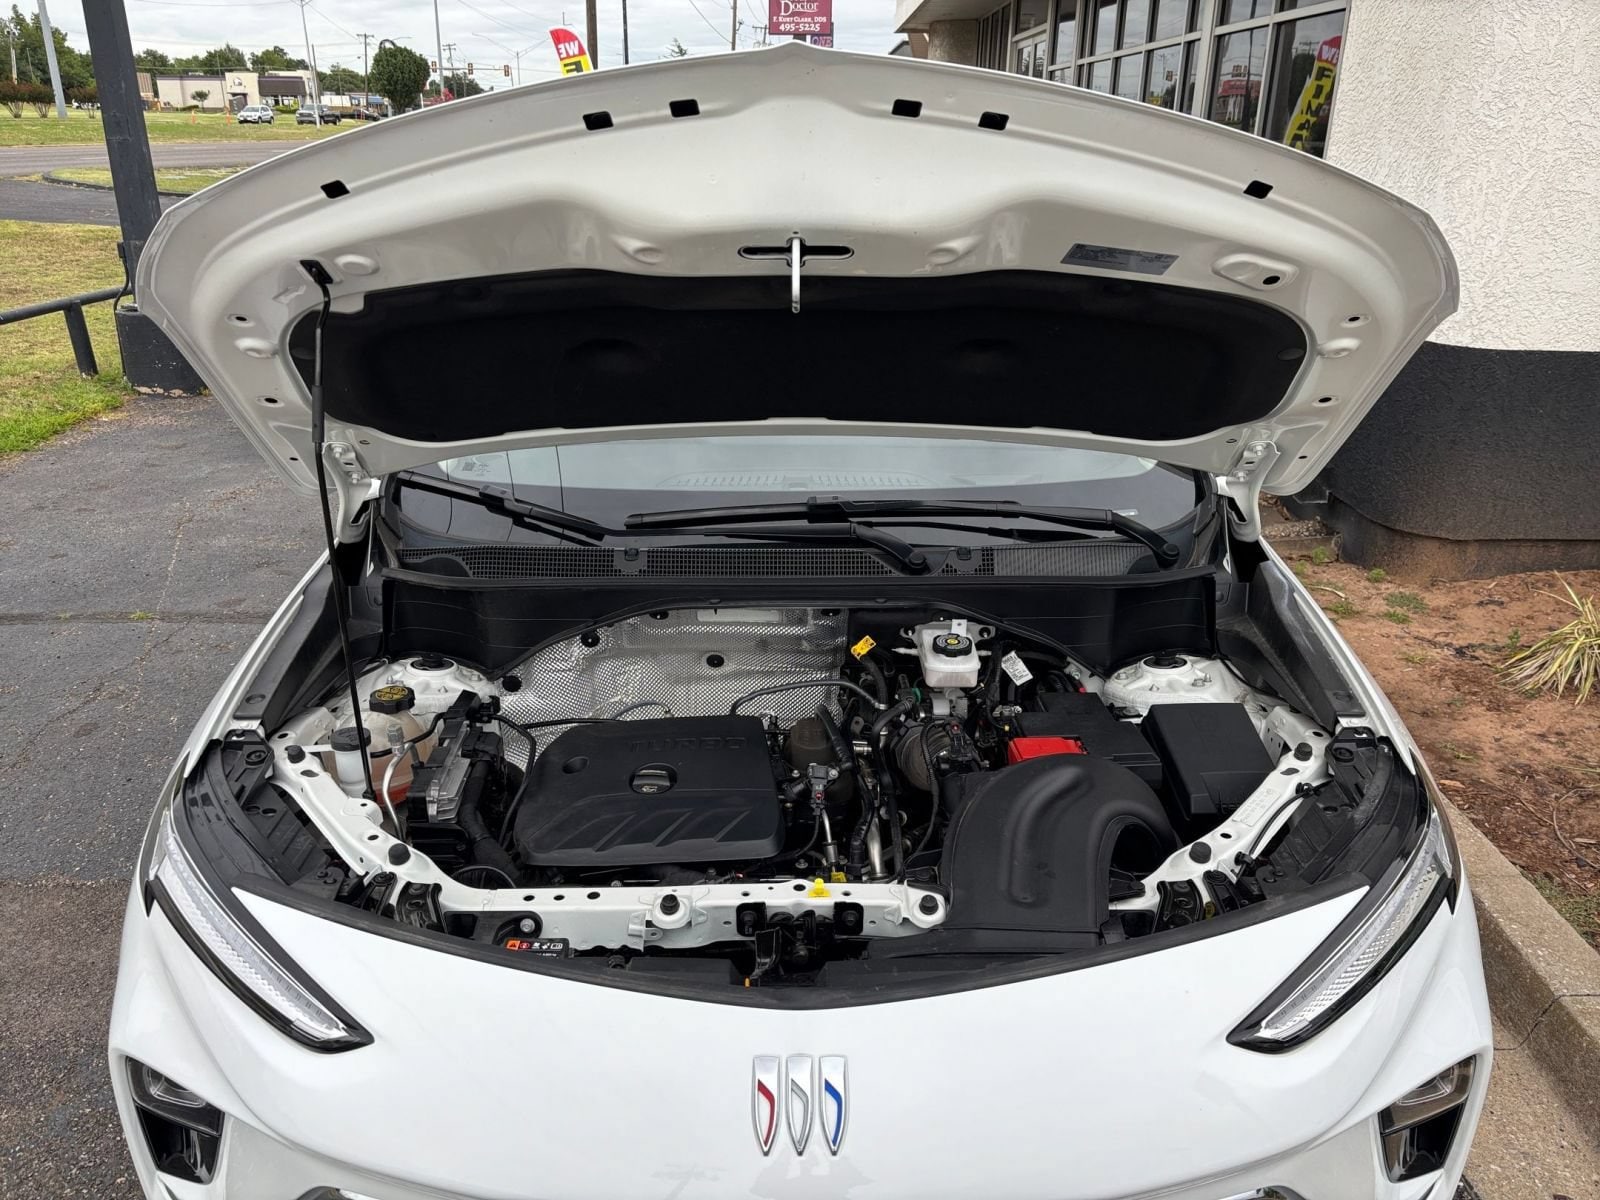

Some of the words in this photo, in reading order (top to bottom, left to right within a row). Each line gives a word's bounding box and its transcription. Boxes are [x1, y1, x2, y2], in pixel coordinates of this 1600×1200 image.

[780, 0, 819, 15] Doctor
[779, 23, 821, 31] 495-5225
[630, 736, 748, 752] TURBO
